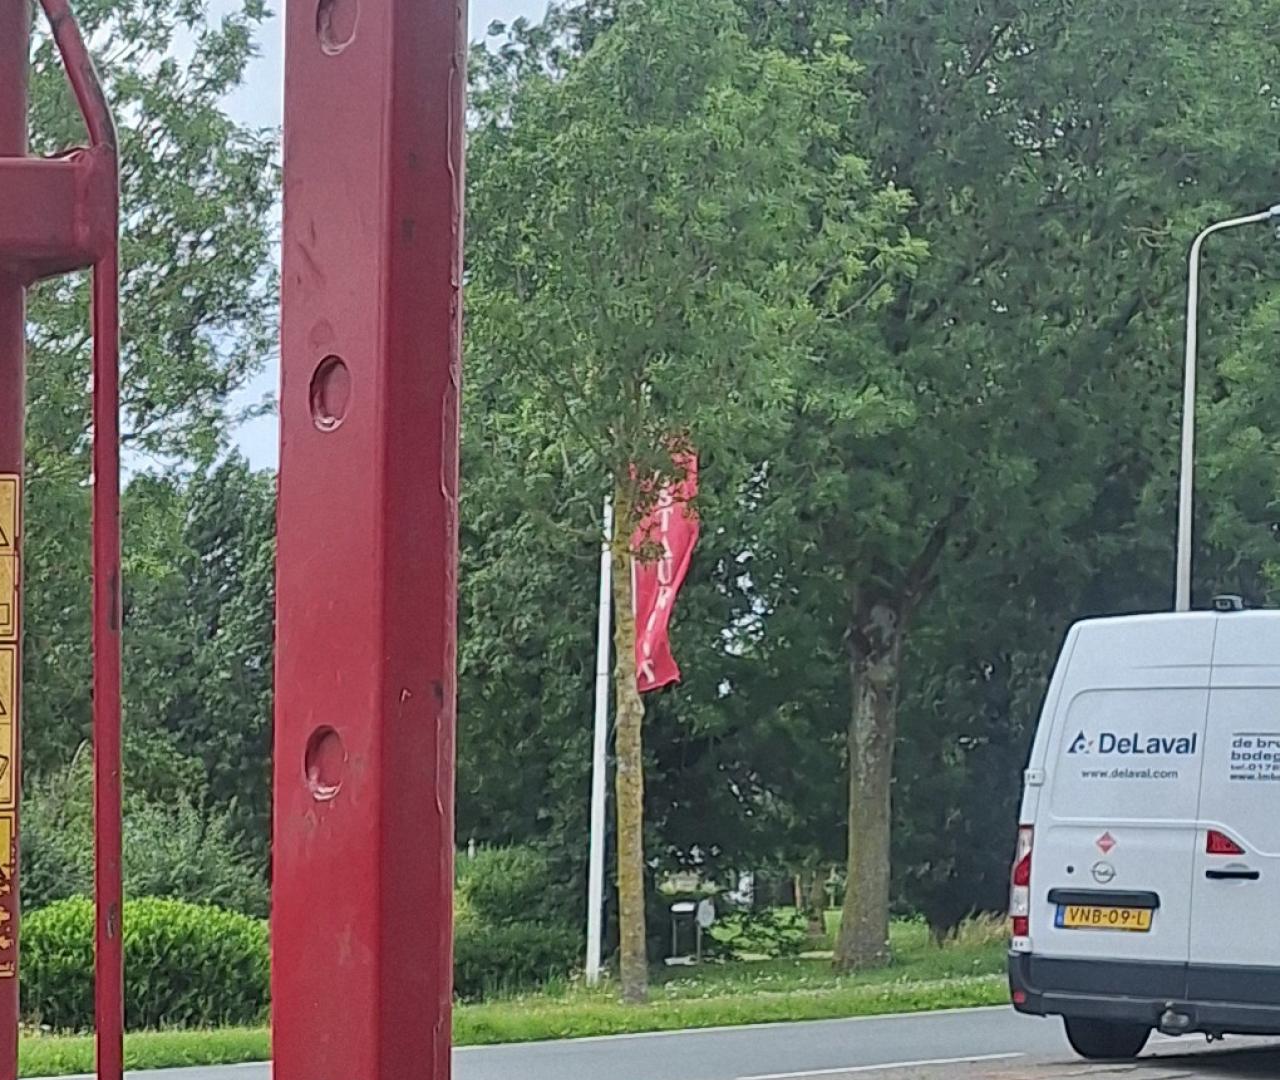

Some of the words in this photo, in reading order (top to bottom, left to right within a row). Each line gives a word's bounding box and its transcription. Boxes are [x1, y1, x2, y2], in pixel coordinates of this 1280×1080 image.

[1099, 732, 1197, 754] DeLaval
[1232, 738, 1252, 748] de
[1081, 768, 1178, 779] www.delaval.com
[1069, 907, 1146, 926] VNB-09-L
